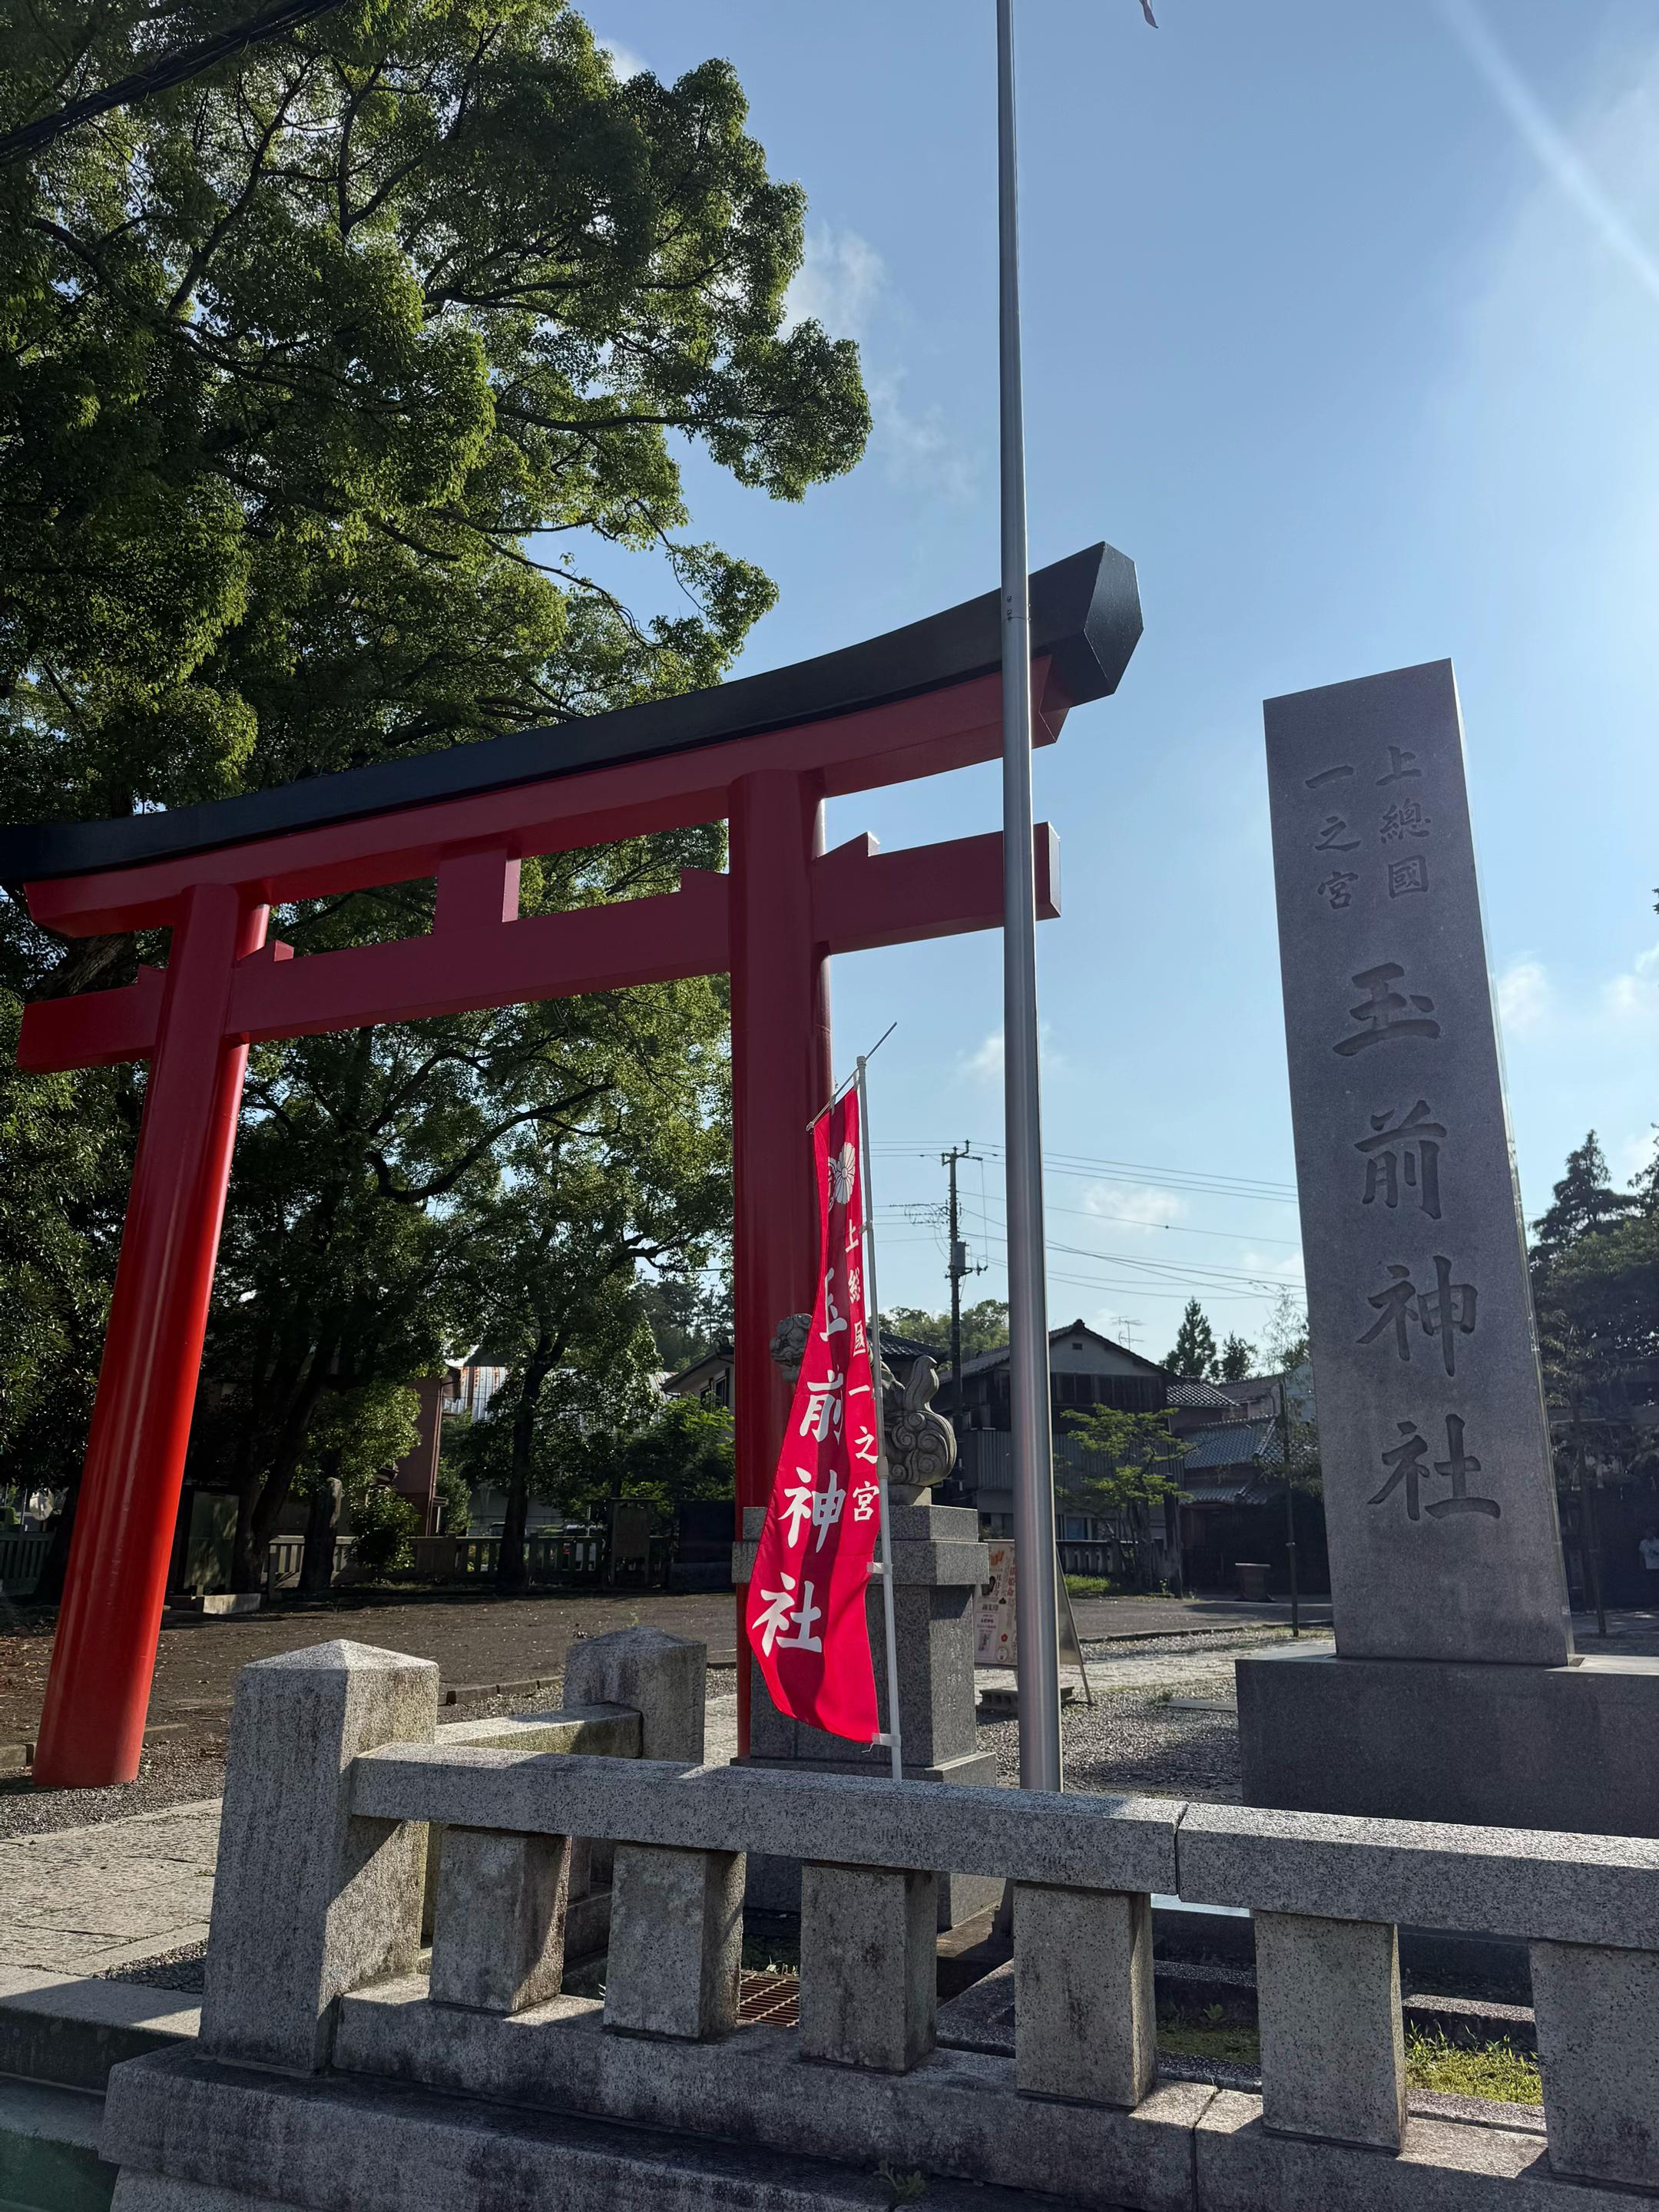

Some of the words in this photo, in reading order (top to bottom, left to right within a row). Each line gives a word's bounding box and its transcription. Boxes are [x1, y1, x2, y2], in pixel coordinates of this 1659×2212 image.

[1306, 765, 1362, 910] 一之宮
[1332, 962, 1501, 1521] 玉前神社
